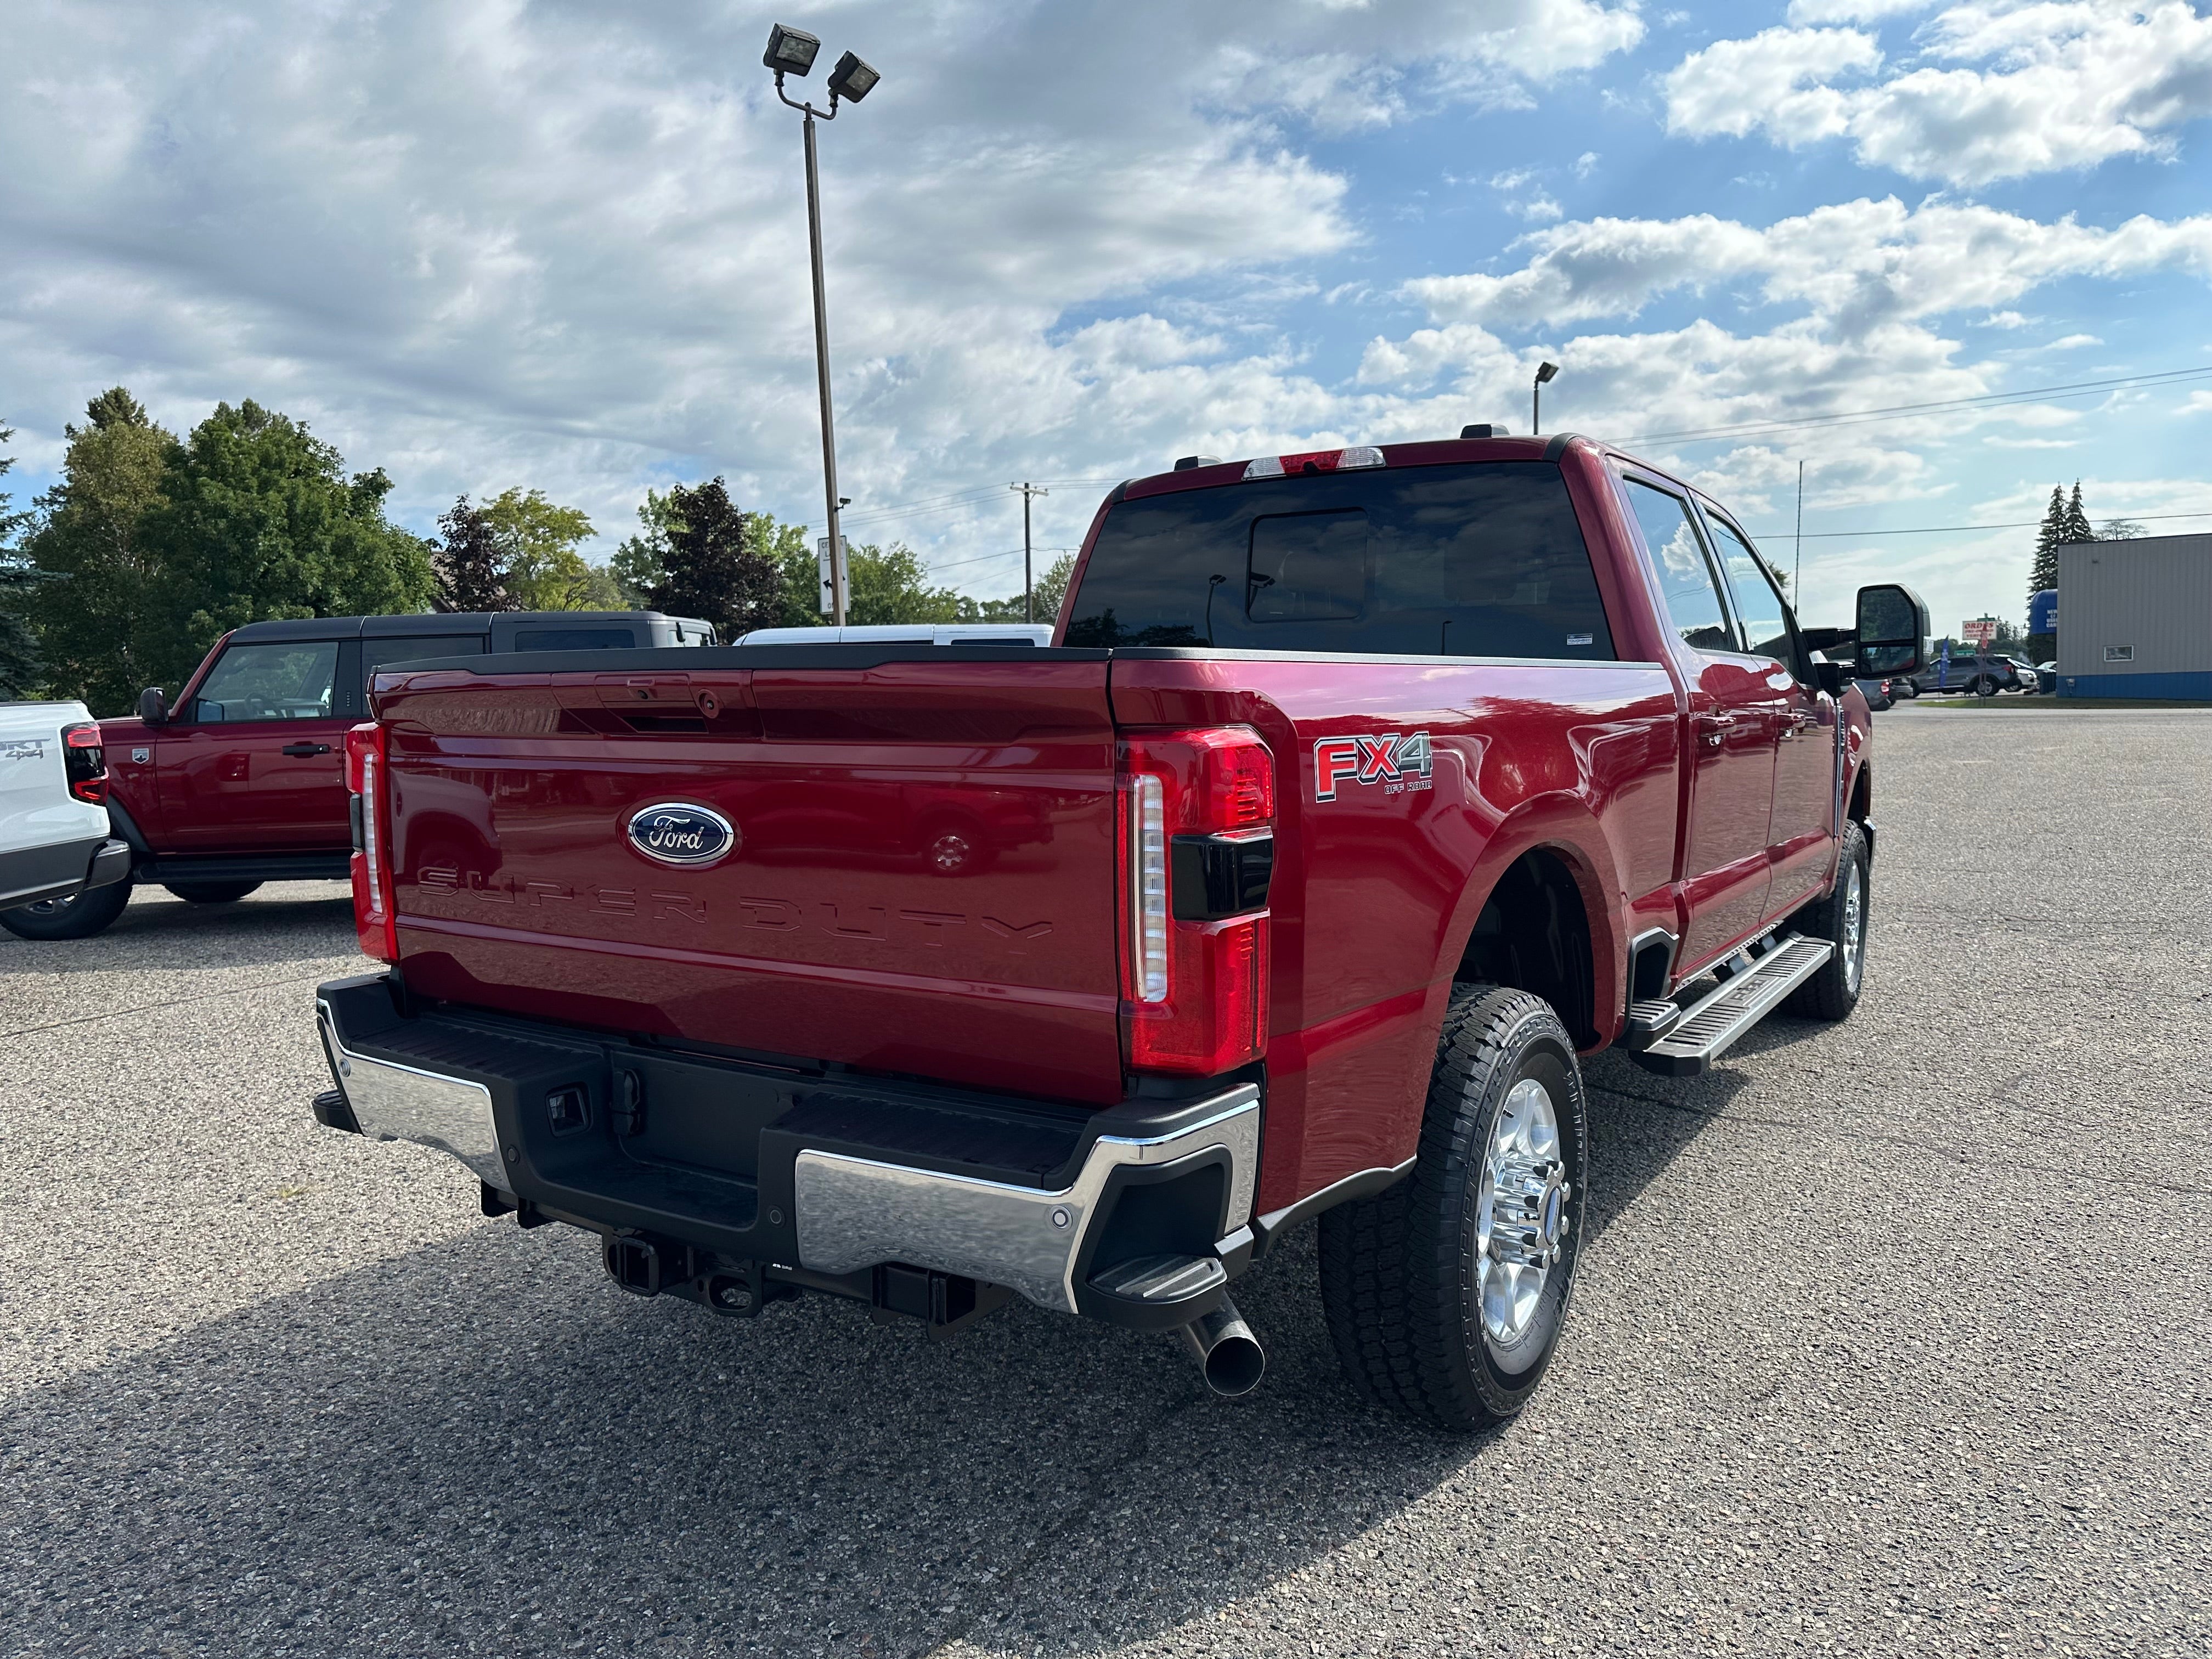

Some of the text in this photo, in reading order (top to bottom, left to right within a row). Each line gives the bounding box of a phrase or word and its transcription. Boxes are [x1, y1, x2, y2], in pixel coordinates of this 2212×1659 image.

[1313, 731, 1433, 803] FX4
[1385, 780, 1432, 795] OFF ROAD
[649, 815, 705, 849] Ford
[417, 866, 1053, 955] SUPER DUTY
